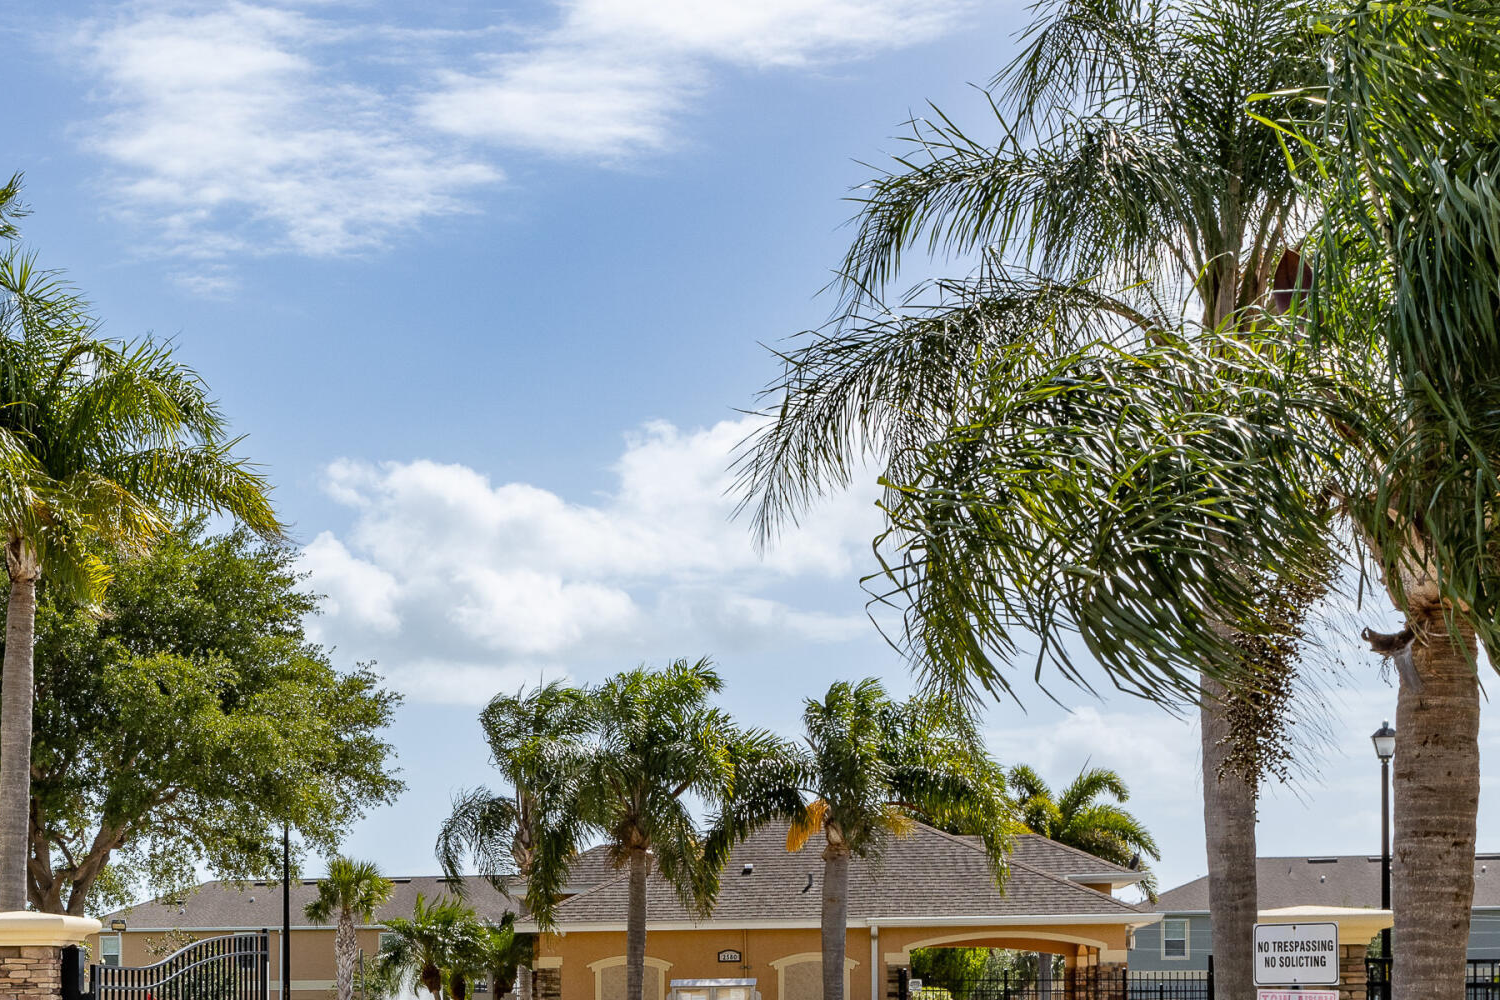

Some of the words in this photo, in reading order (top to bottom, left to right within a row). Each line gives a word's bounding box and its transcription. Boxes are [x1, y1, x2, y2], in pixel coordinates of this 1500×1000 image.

[1257, 941, 1270, 953] NO
[1272, 940, 1334, 952] TRESPASSING
[1264, 956, 1276, 968] NO
[1279, 955, 1326, 968] SOLICTING
